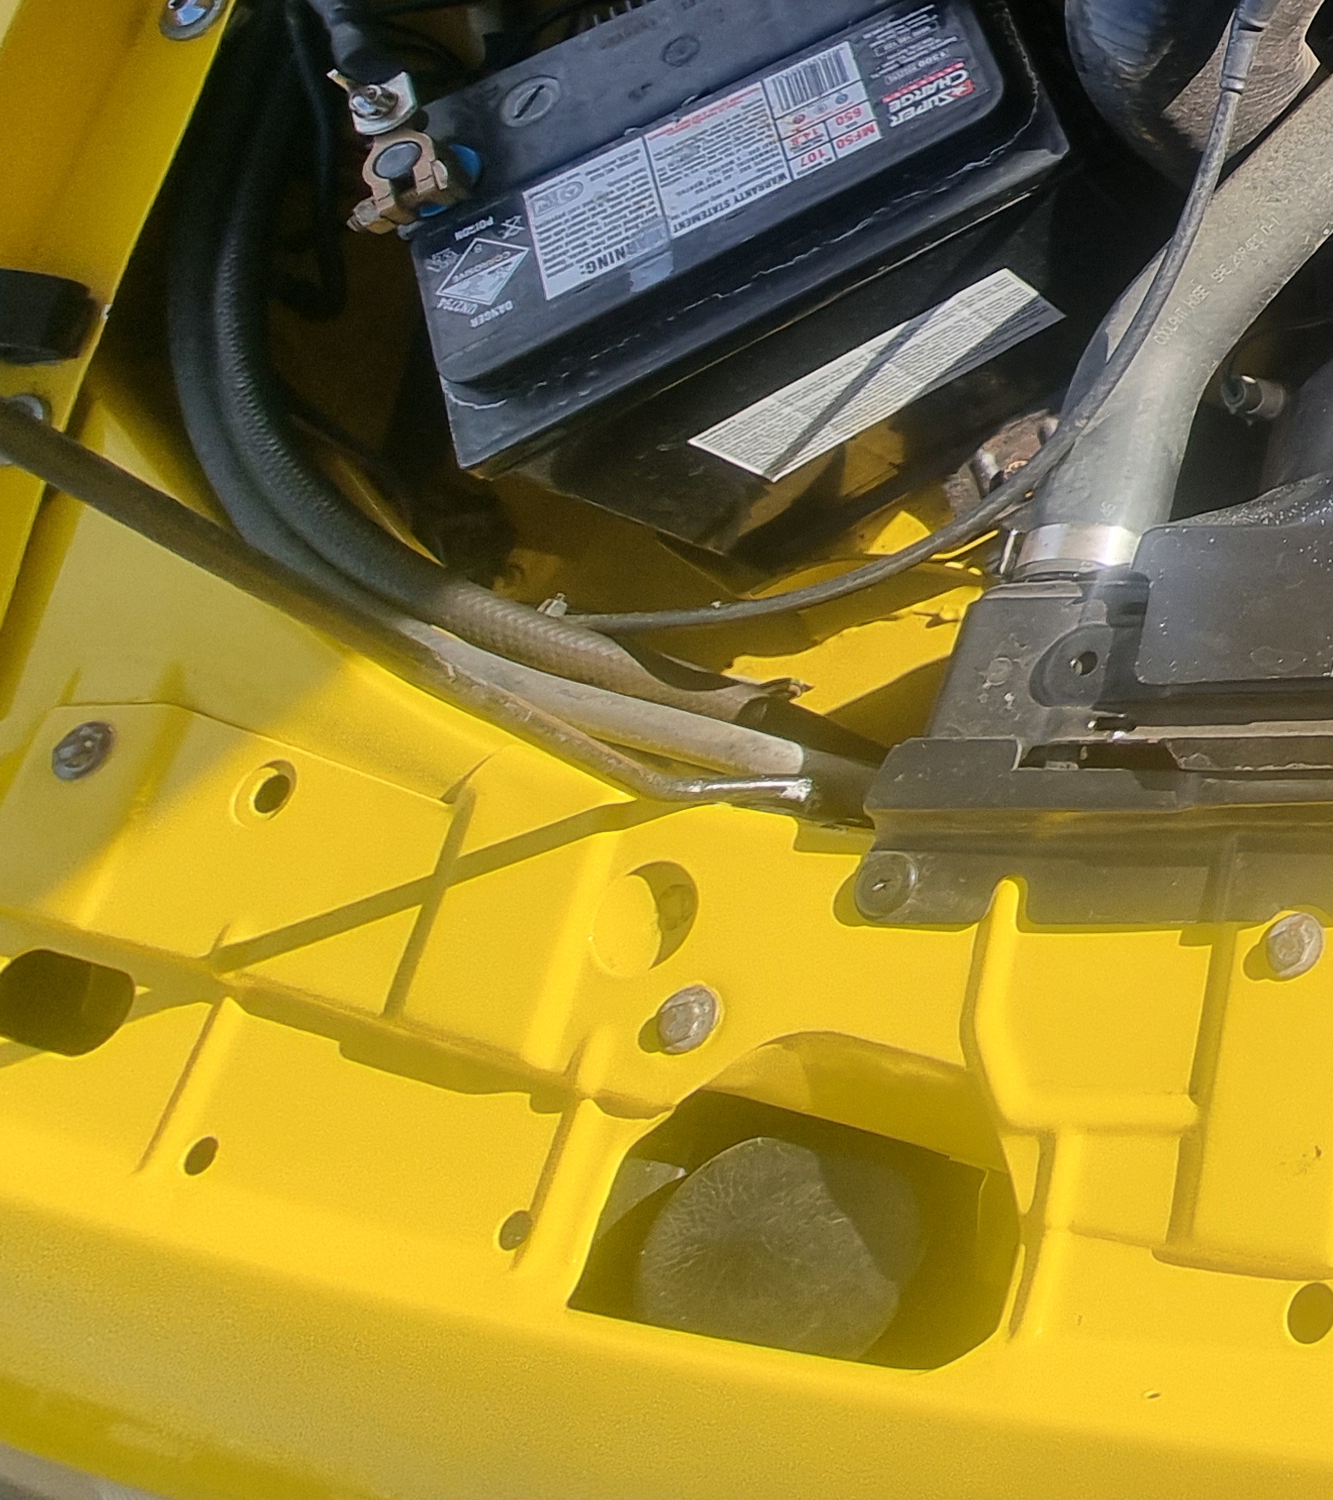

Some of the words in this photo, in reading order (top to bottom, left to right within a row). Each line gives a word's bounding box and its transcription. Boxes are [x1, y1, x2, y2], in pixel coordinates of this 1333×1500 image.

[889, 69, 969, 113] CHARGE
[835, 107, 862, 126] 650
[889, 87, 953, 128] SUPER
[800, 148, 826, 167] 107
[733, 172, 788, 203] WARRANTY
[455, 216, 494, 241] POISON
[672, 199, 731, 233] STATEMENT
[452, 251, 511, 283] CORROSIVE
[470, 300, 513, 329] DANGER
